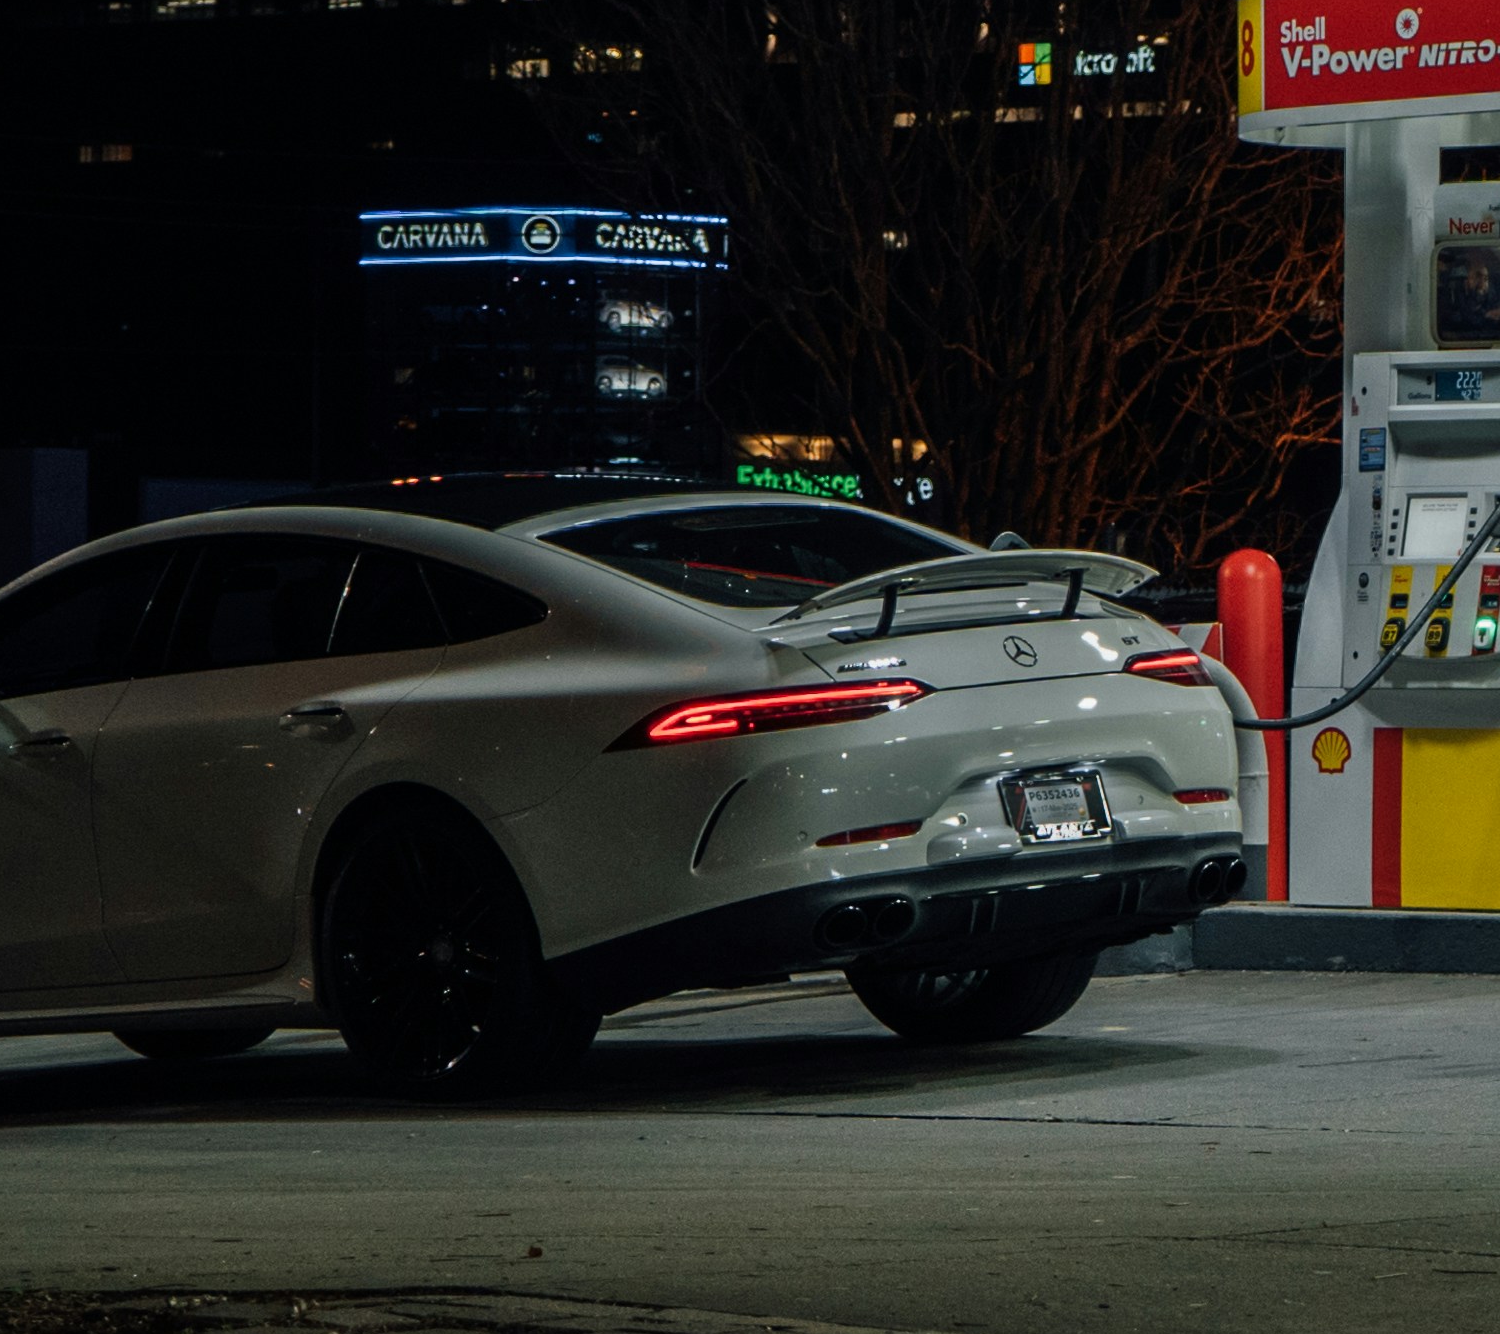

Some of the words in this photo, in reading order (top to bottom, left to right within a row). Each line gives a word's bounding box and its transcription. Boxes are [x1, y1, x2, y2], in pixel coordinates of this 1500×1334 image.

[1280, 16, 1325, 45] Shell
[1242, 19, 1256, 77] 8
[1280, 43, 1410, 78] V-Power
[378, 223, 490, 249] CARVANA
[1448, 217, 1495, 236] Never
[1382, 629, 1398, 641] 87
[1427, 629, 1441, 641] 89
[1028, 787, 1081, 802] P6352436
